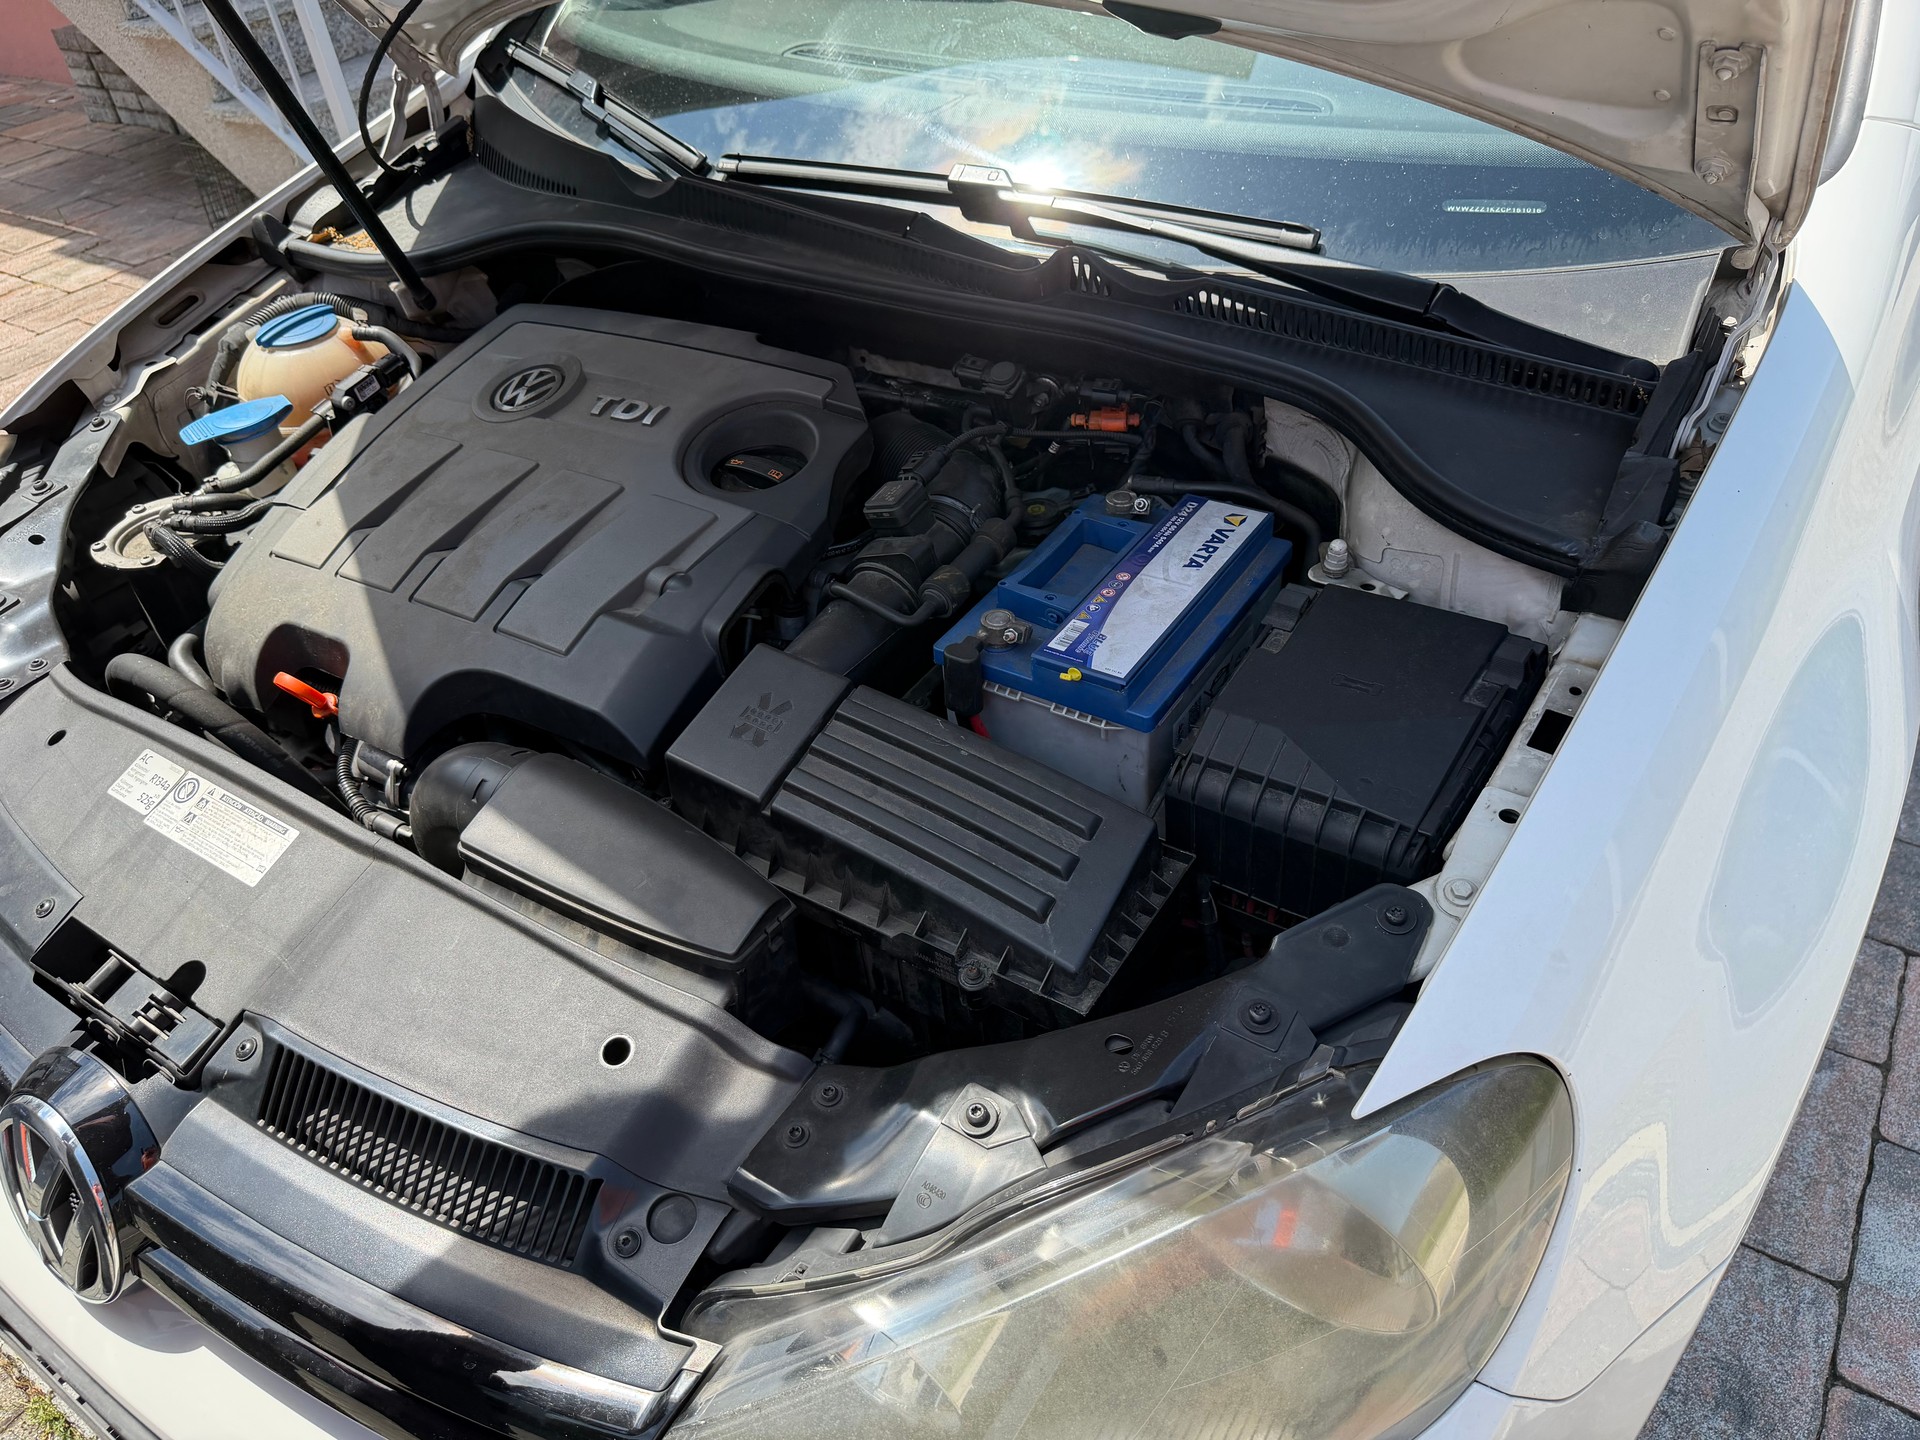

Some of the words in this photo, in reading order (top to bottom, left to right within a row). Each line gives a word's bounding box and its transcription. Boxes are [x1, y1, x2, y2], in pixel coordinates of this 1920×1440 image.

[589, 394, 670, 426] TDI
[1182, 528, 1236, 569] VARTA
[1083, 633, 1108, 657] BLUE
[139, 753, 154, 765] AC
[149, 773, 171, 791] R134a
[136, 792, 156, 811] 525g
